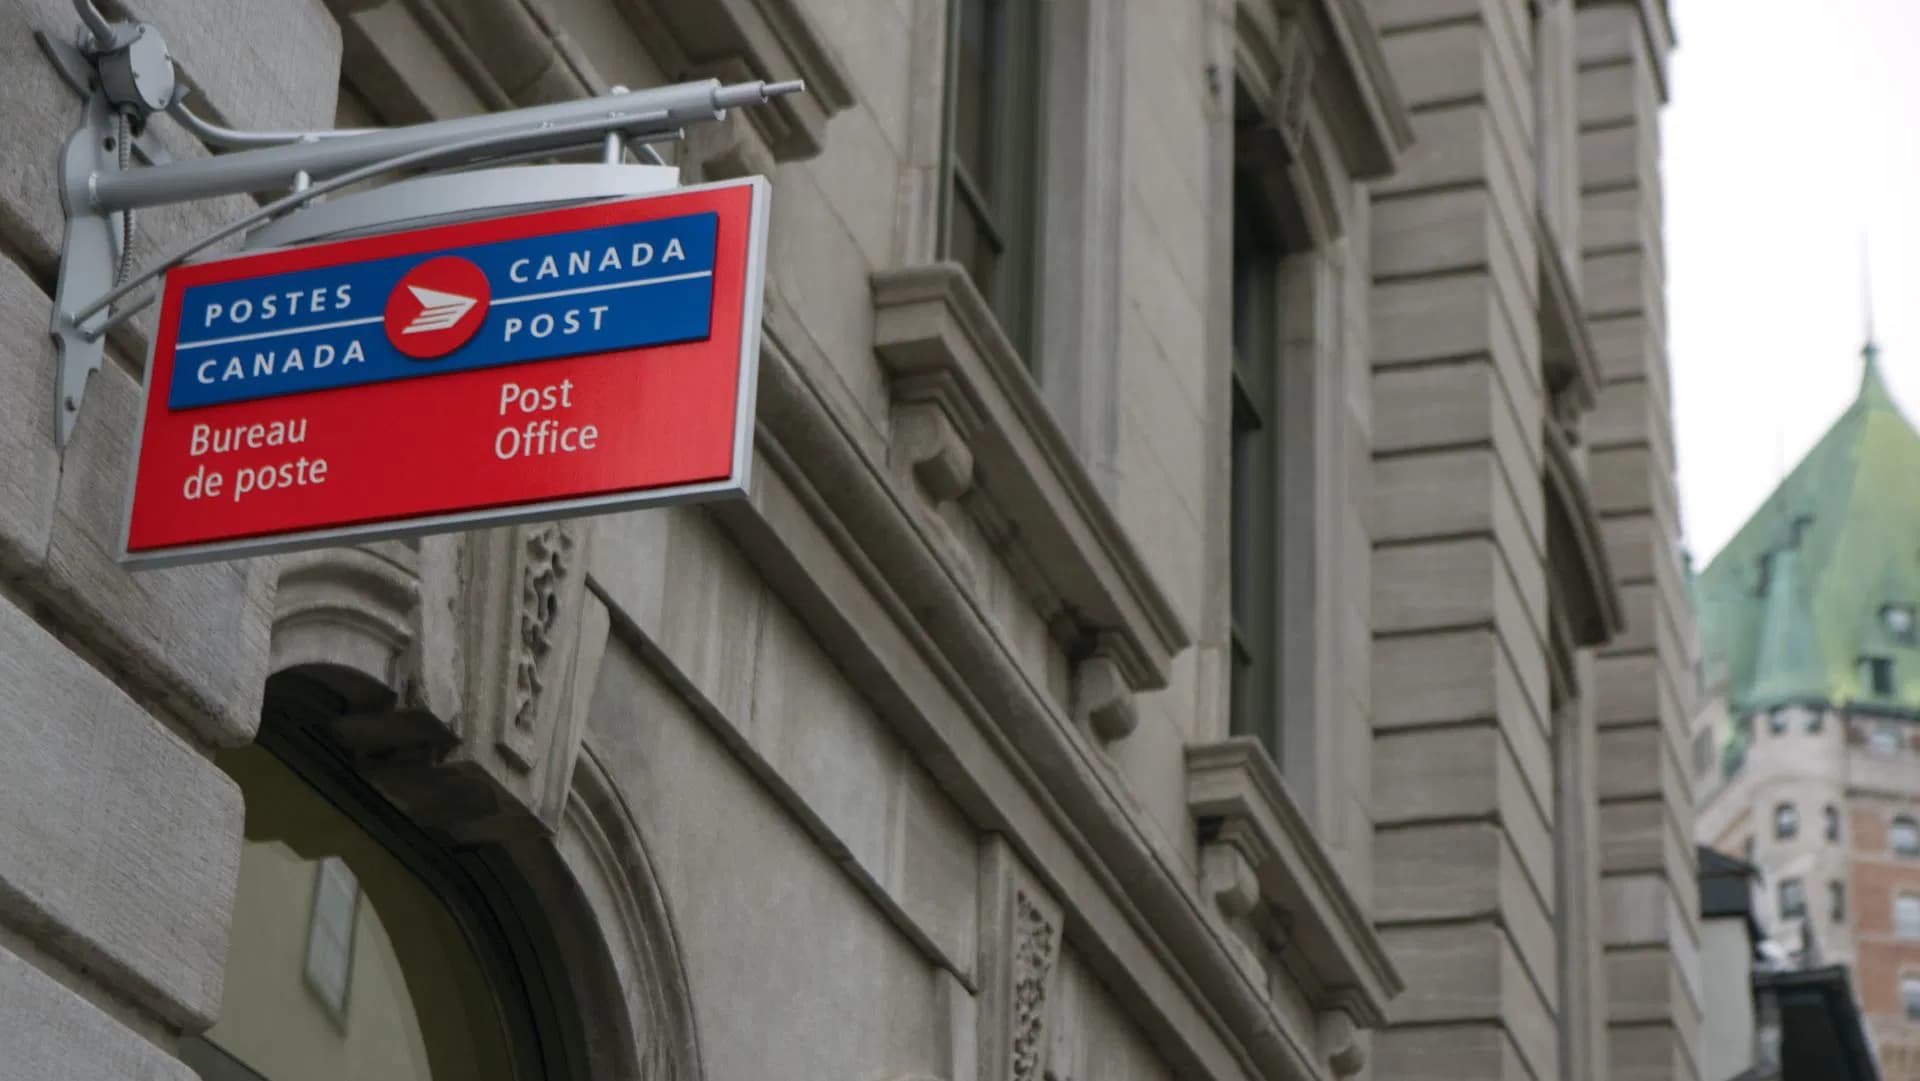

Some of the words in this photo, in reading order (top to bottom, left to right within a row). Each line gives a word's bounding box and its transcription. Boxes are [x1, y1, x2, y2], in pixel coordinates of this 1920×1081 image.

[510, 238, 686, 283] CANADA
[206, 285, 352, 326] POSTES
[504, 306, 610, 341] POST
[198, 340, 365, 383] CANADA
[499, 379, 574, 416] Post
[190, 418, 307, 455] Bureau
[494, 419, 599, 460] Office
[183, 465, 224, 500] de
[234, 457, 328, 503] poste
